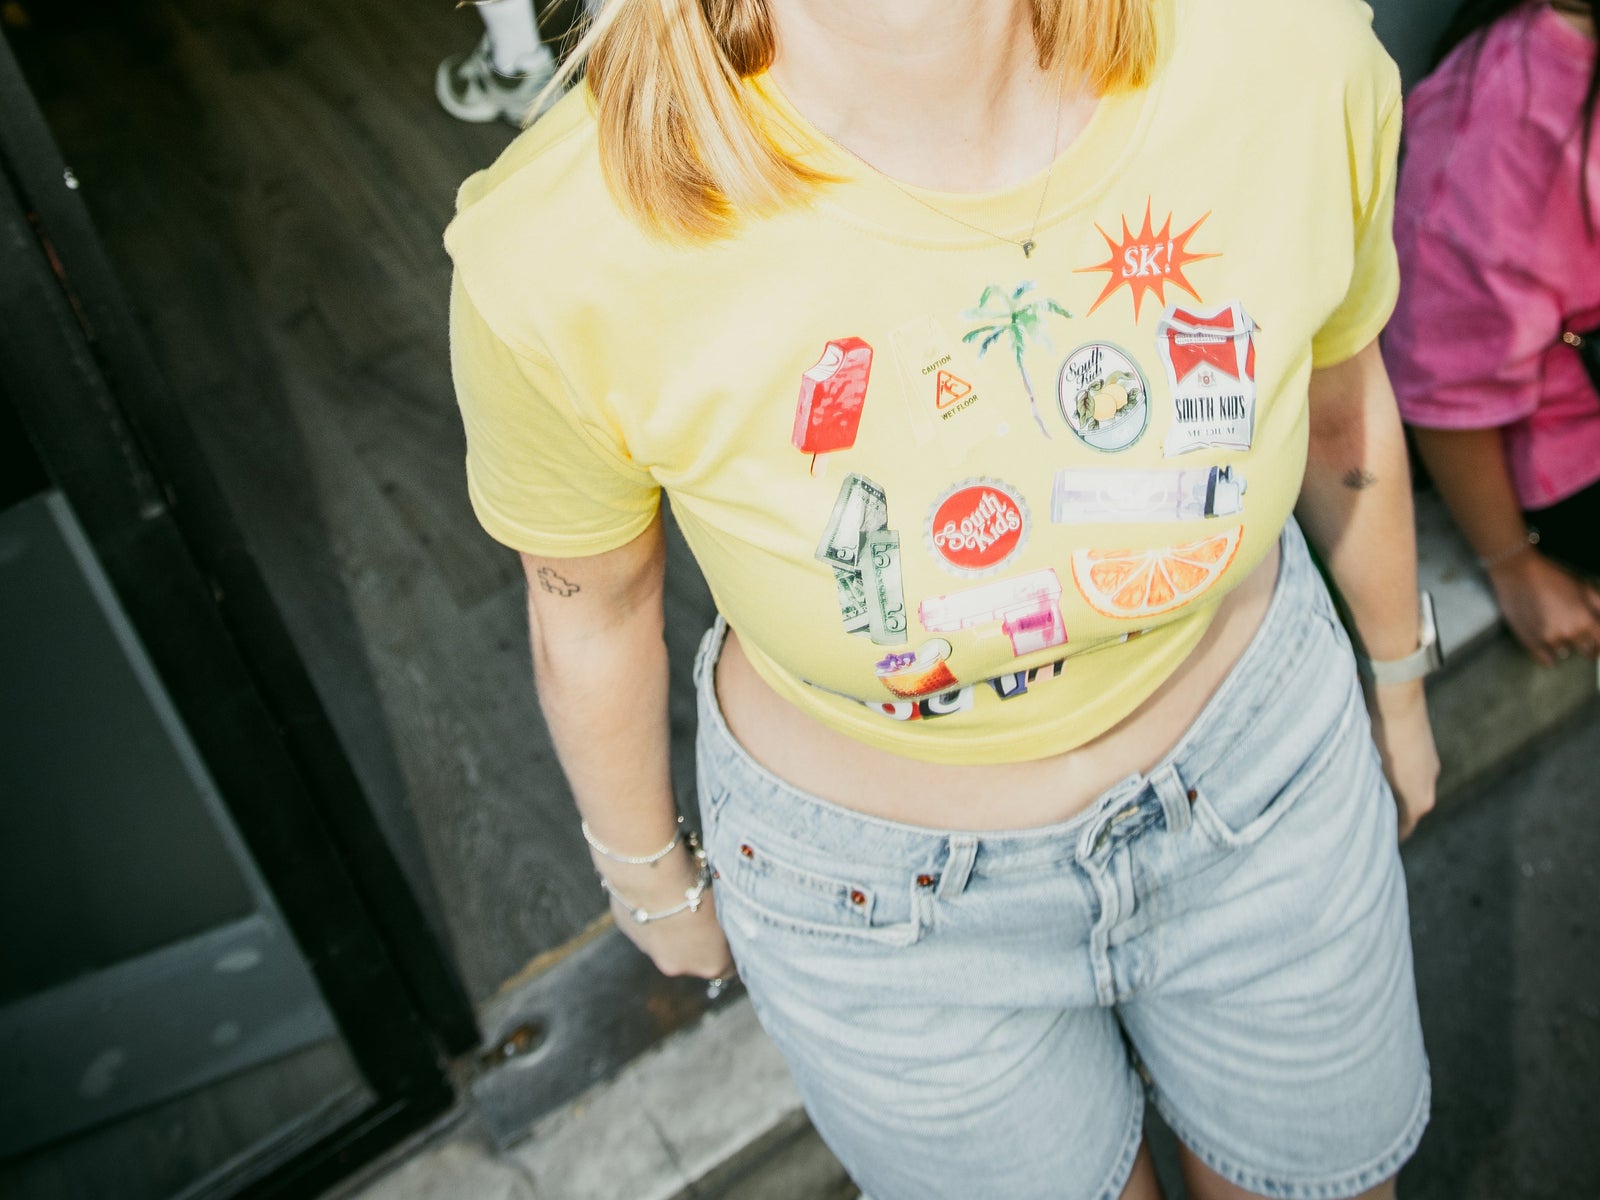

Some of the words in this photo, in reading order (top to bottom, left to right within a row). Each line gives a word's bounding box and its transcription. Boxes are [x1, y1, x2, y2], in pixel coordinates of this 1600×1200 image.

[1122, 238, 1174, 278] SK!
[921, 354, 952, 376] CAUTION
[1066, 347, 1103, 382] South
[942, 408, 957, 421] WET
[956, 394, 979, 412] FLOOR
[1175, 397, 1214, 424] SOUTH
[1219, 395, 1246, 421] KIDS
[934, 490, 1007, 551] South
[965, 507, 1021, 554] Kids
